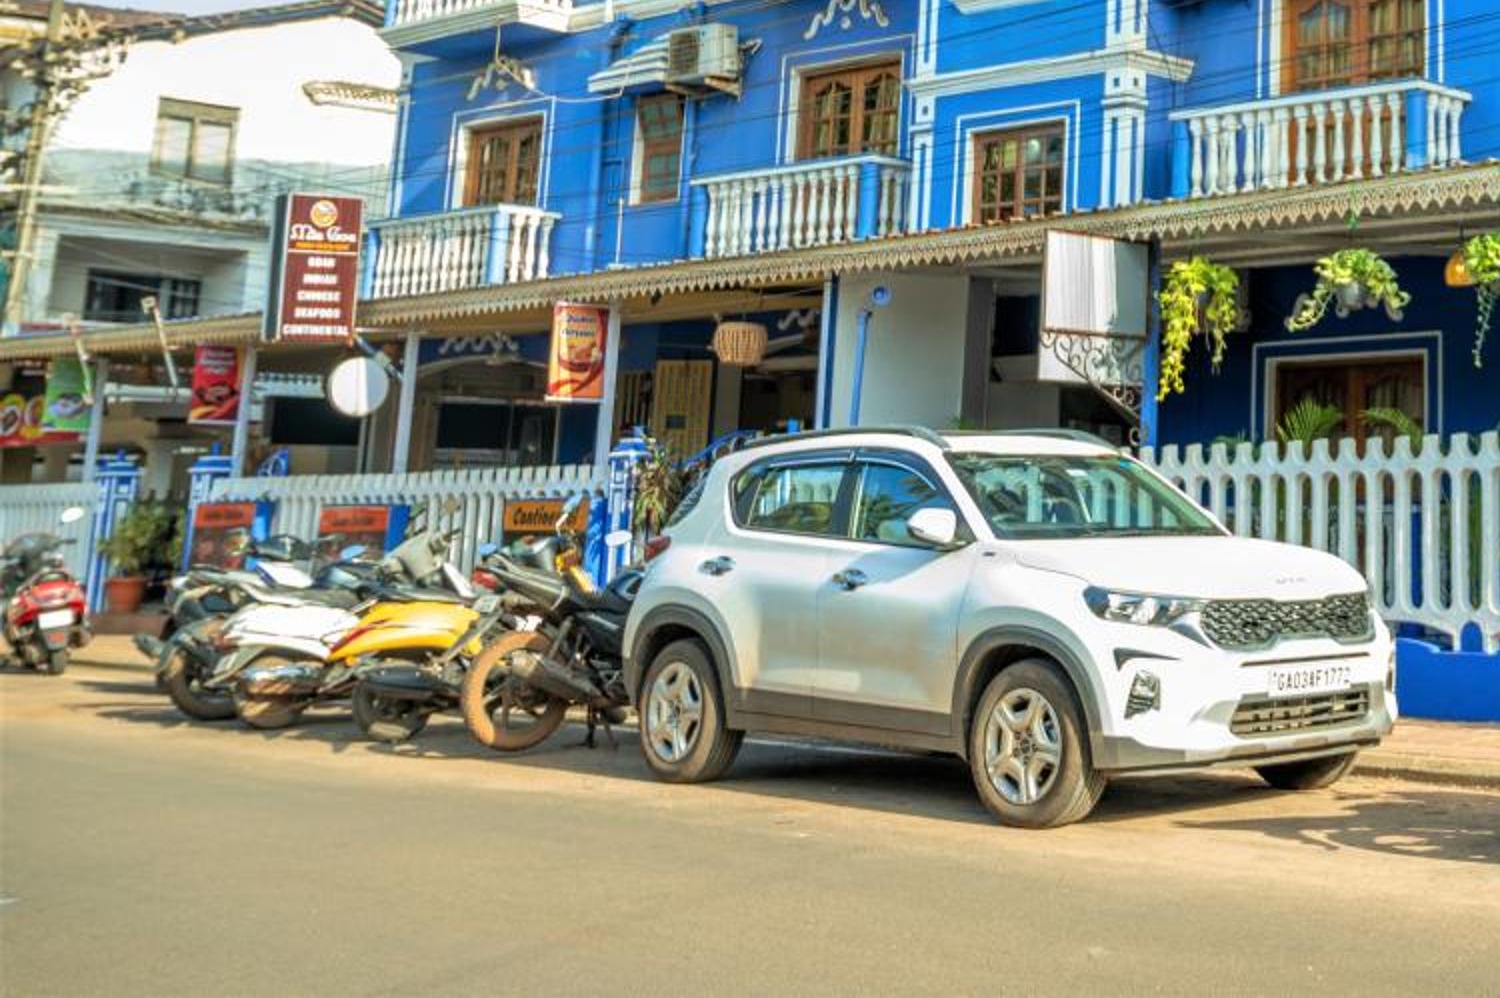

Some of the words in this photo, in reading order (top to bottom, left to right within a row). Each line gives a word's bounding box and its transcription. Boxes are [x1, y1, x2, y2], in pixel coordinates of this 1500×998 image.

[296, 290, 341, 302] CHINESE
[294, 306, 341, 319] SEAFOOD
[282, 323, 349, 336] CONTINENTAL
